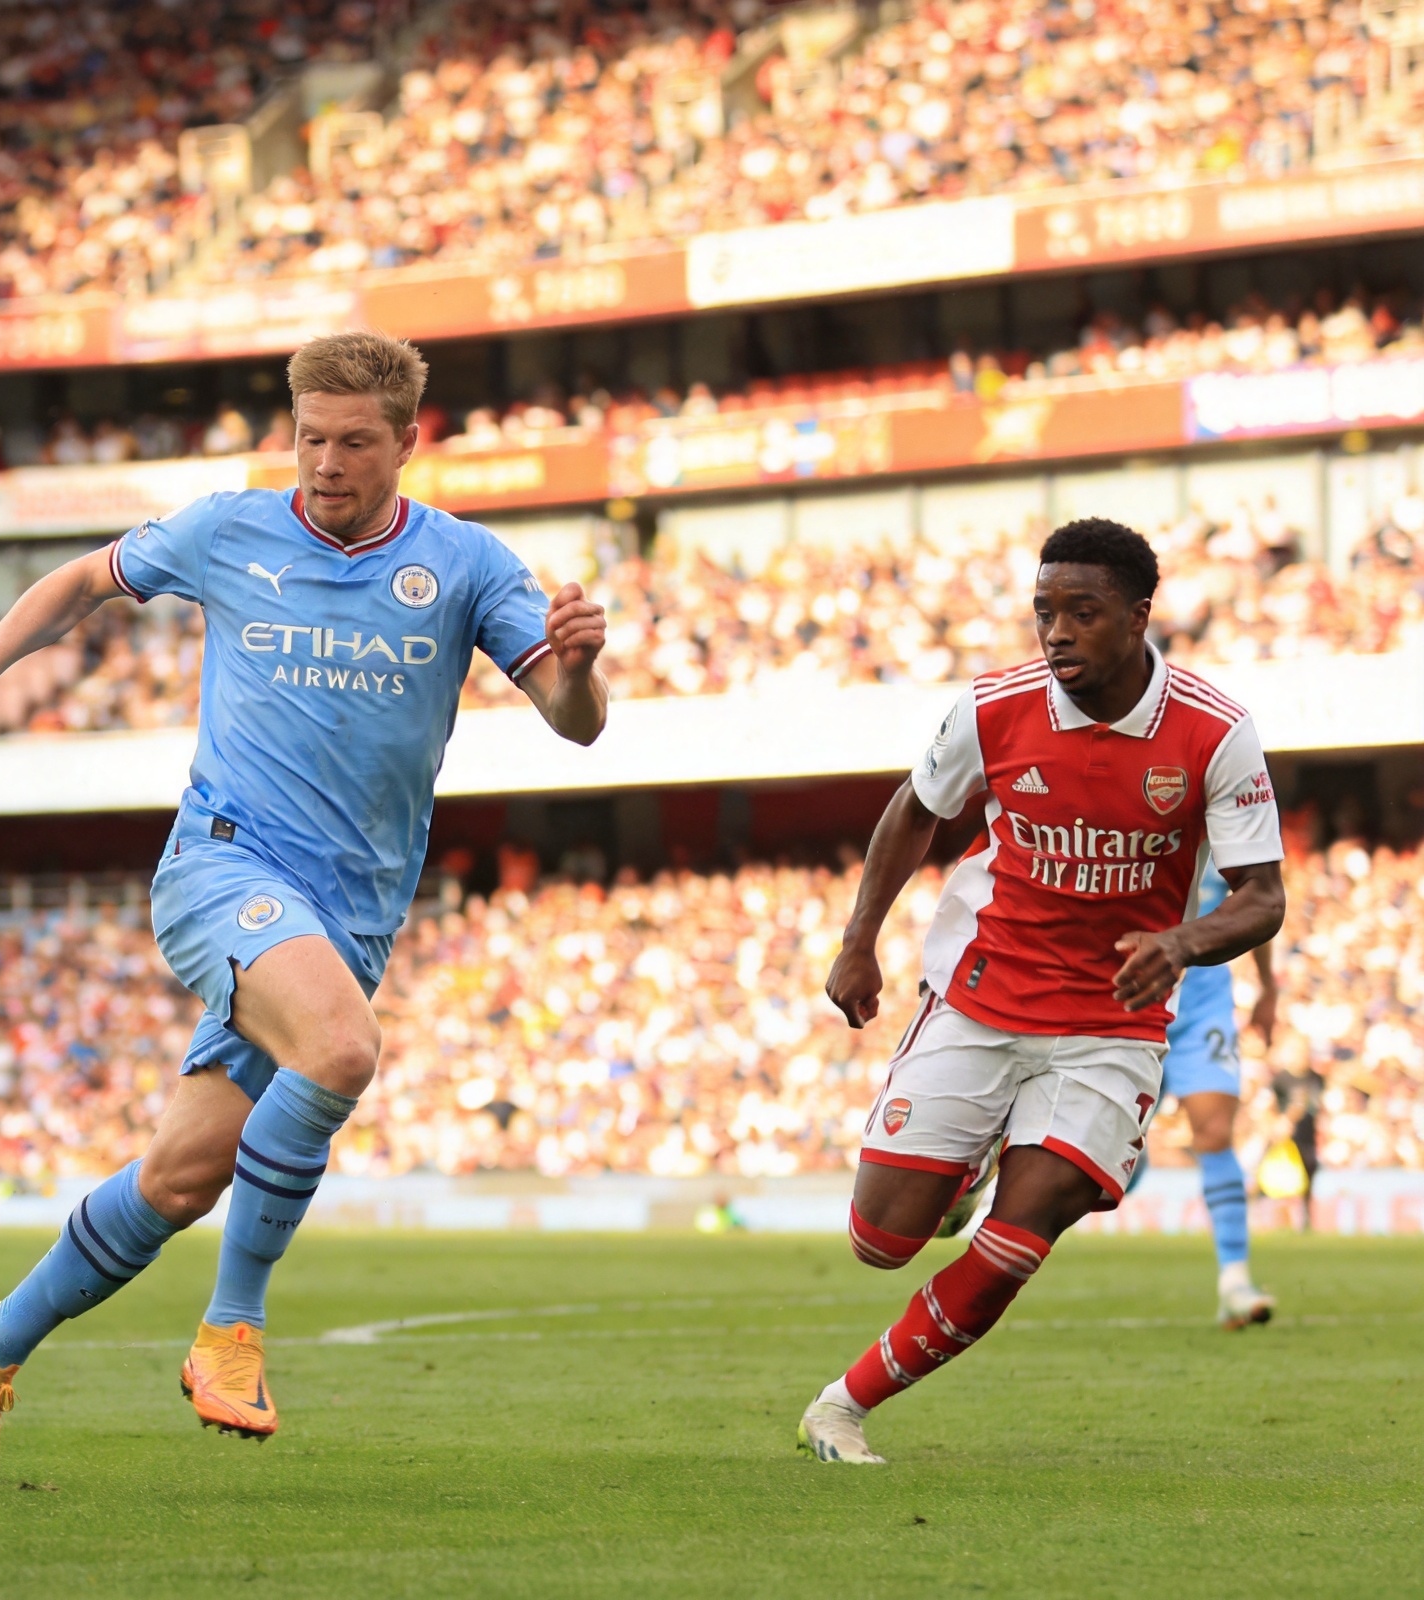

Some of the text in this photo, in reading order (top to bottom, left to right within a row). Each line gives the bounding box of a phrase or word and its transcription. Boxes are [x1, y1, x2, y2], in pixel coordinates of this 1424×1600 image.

[241, 621, 438, 665] ETIHAD
[271, 664, 406, 696] AIRWAYS
[1005, 809, 1183, 860] Emirates
[1074, 861, 1156, 894] BETTER
